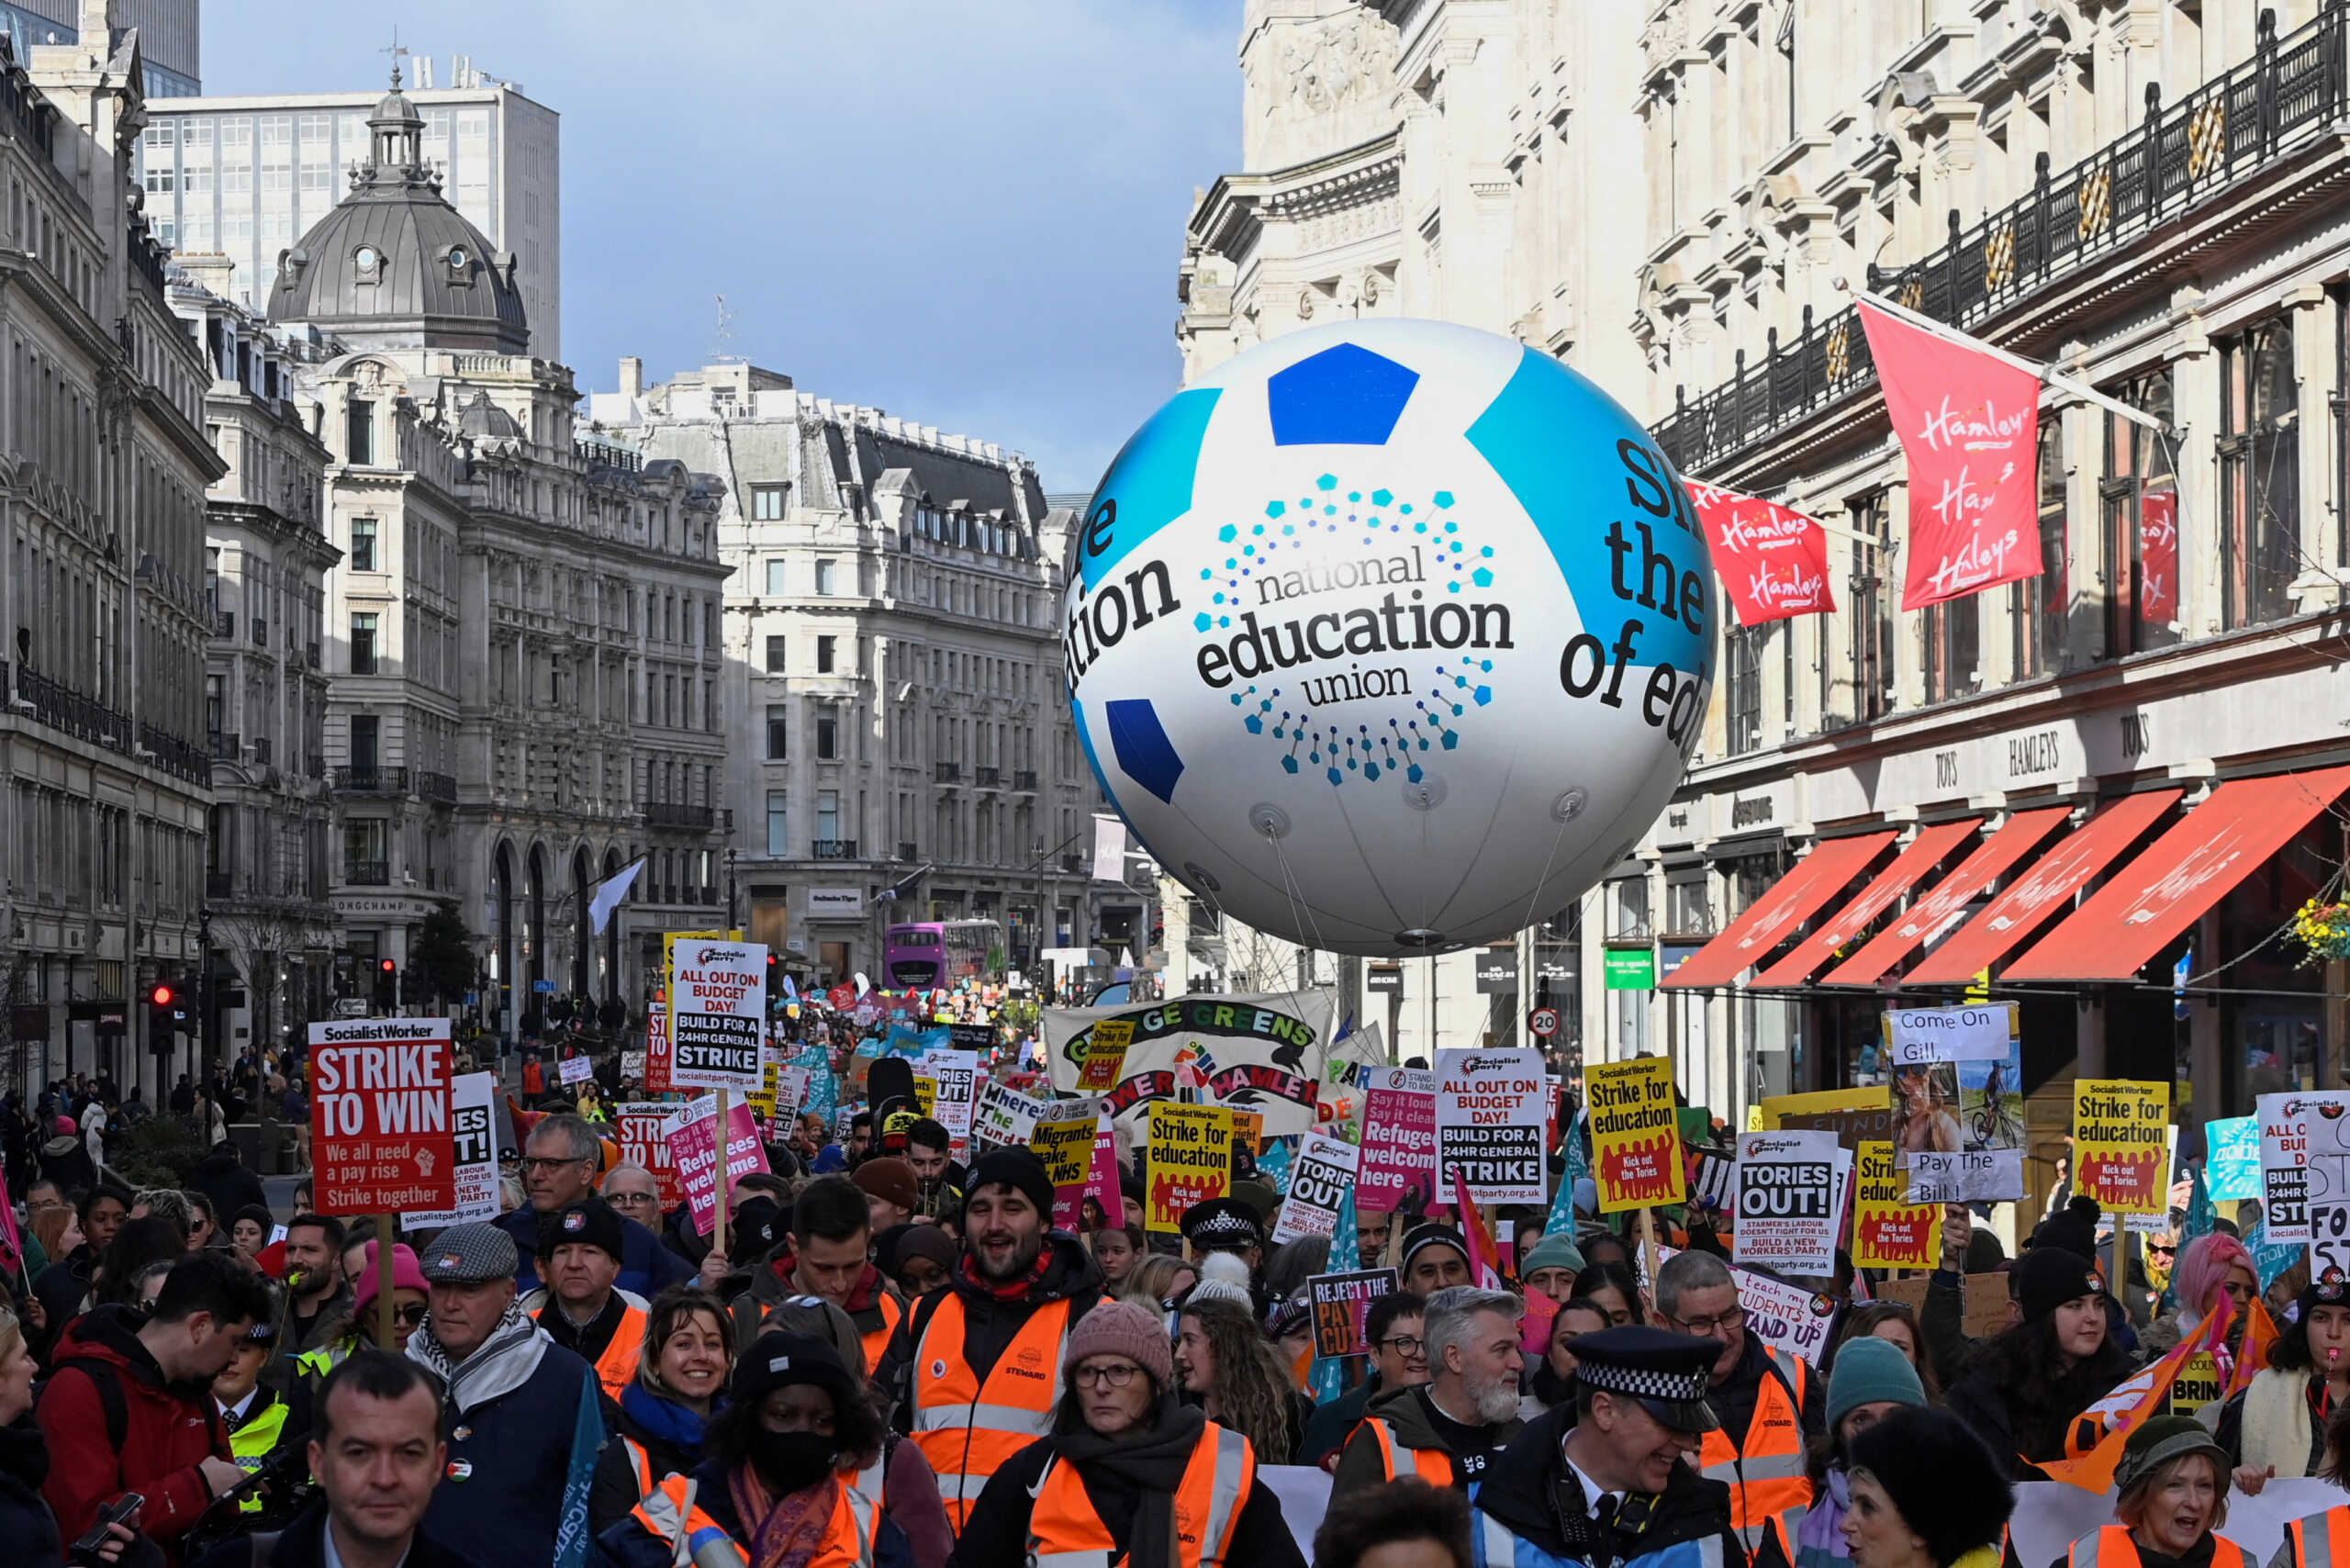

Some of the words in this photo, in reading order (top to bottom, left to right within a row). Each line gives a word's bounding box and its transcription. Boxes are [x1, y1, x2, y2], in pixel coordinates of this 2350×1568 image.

[1255, 545, 1427, 605] national
[1604, 521, 1706, 636] the
[1197, 588, 1515, 689] education
[1560, 619, 1644, 709] of
[1301, 663, 1412, 707] union
[1935, 751, 1958, 789] TOYS
[2009, 731, 2059, 777] HAMLEYS
[333, 901, 404, 912] ONGCHAMP
[680, 969, 706, 982] ALL
[710, 972, 739, 985] OUT
[739, 974, 759, 987] ON
[693, 985, 747, 1000] BUDGET
[705, 1000, 737, 1014] DAY!
[678, 1015, 721, 1029] BUILD
[723, 1018, 745, 1032] FOR
[747, 1020, 757, 1033] A
[1194, 1005, 1310, 1047] GREENS
[1535, 1016, 1555, 1028] 20
[1901, 1013, 1955, 1029] Come
[1962, 1011, 1990, 1026] On
[651, 1036, 667, 1056] TO
[678, 1032, 709, 1043] 24HR
[711, 1034, 757, 1047] GENERAL
[677, 1046, 756, 1070] STRIKE
[1904, 1043, 1942, 1062] Gill,
[317, 1045, 444, 1092] STRIKE
[938, 1070, 971, 1083] RIES
[1408, 1073, 1431, 1083] STAND
[677, 1072, 757, 1085] socialistparty.org.uk
[1442, 1081, 1472, 1093] ALL
[1475, 1081, 1509, 1093] OUT
[1513, 1080, 1538, 1093] ON
[1101, 1071, 1175, 1116] OWER
[1371, 1092, 1393, 1106] Say
[1395, 1093, 1405, 1106] it
[1408, 1095, 1435, 1110] loud
[1590, 1080, 1640, 1108] Strike
[1644, 1076, 1669, 1101] for
[1457, 1095, 1524, 1109] BUDGET
[2078, 1095, 2131, 1118] Strike
[2137, 1097, 2165, 1120] for
[318, 1092, 364, 1137] TO
[375, 1090, 446, 1135] WIN
[453, 1109, 487, 1131] IES
[979, 1102, 1013, 1130] The
[1369, 1106, 1390, 1122] Say
[1393, 1108, 1404, 1121] it
[1472, 1111, 1509, 1124] DAY!
[1595, 1103, 1673, 1135] education
[1813, 1114, 1888, 1132] FUND
[672, 1132, 689, 1146] Say
[692, 1125, 699, 1137] it
[1034, 1125, 1094, 1148] Migrants
[1152, 1117, 1199, 1142] Strike
[1204, 1122, 1228, 1145] for
[1443, 1129, 1490, 1142] BUILD
[1493, 1129, 1524, 1142] FOR
[1527, 1129, 1539, 1141] A
[2078, 1120, 2163, 1143] education
[2266, 1124, 2293, 1137] ALL
[326, 1145, 348, 1161] We
[352, 1143, 370, 1160] all
[376, 1141, 410, 1160] need
[675, 1144, 694, 1158] Say
[696, 1137, 705, 1148] it
[1151, 1142, 1227, 1169] education
[1442, 1147, 1478, 1157] 24HR
[1480, 1147, 1539, 1157] GENERAL
[1363, 1147, 1436, 1169] welcom
[1623, 1156, 1640, 1168] Kick
[1641, 1154, 1653, 1164] out
[1919, 1155, 1953, 1172] Pay
[1961, 1153, 1993, 1170] The
[327, 1167, 336, 1181] a
[341, 1165, 367, 1183] pay
[371, 1162, 400, 1179] rise
[1052, 1162, 1080, 1182] NHS
[1360, 1165, 1404, 1189] here
[1444, 1160, 1539, 1181] STRIKE
[1621, 1170, 1634, 1181] the
[1636, 1167, 1658, 1178] Tories
[1743, 1165, 1829, 1185] TORIES
[2102, 1165, 2120, 1175] Kick
[2121, 1165, 2135, 1175] out
[459, 1184, 482, 1195] NEW
[2098, 1176, 2112, 1185] the
[2114, 1176, 2138, 1186] Tories
[328, 1189, 372, 1207] Strike
[377, 1187, 439, 1208] together
[461, 1192, 493, 1202] PARTY
[1172, 1186, 1188, 1197] Kick
[1190, 1189, 1203, 1198] out
[1742, 1187, 1827, 1215] OUT!
[1919, 1184, 1948, 1202] Bill
[2268, 1188, 2302, 1199] 24HR
[1169, 1197, 1181, 1207] the
[405, 1204, 494, 1224] socialistparty.org.uk
[1881, 1223, 1897, 1232] Kick
[1899, 1224, 1911, 1232] out
[1751, 1238, 1783, 1247] BUILD
[1785, 1238, 1791, 1247] A
[1794, 1238, 1818, 1247] NEW
[1877, 1234, 1890, 1243] the
[1892, 1234, 1913, 1243] Tories
[1796, 1247, 1830, 1256] PARTY
[1315, 1281, 1361, 1303] REJECT
[1364, 1277, 1389, 1298] THE
[1746, 1273, 1782, 1296] teach
[1787, 1294, 1806, 1310] my
[1318, 1300, 1354, 1327] PAY
[1810, 1316, 1824, 1329] to
[1794, 1325, 1821, 1349] UP
[1006, 1367, 1046, 1381] STEWARD
[2173, 1380, 2221, 1401] BRIN
